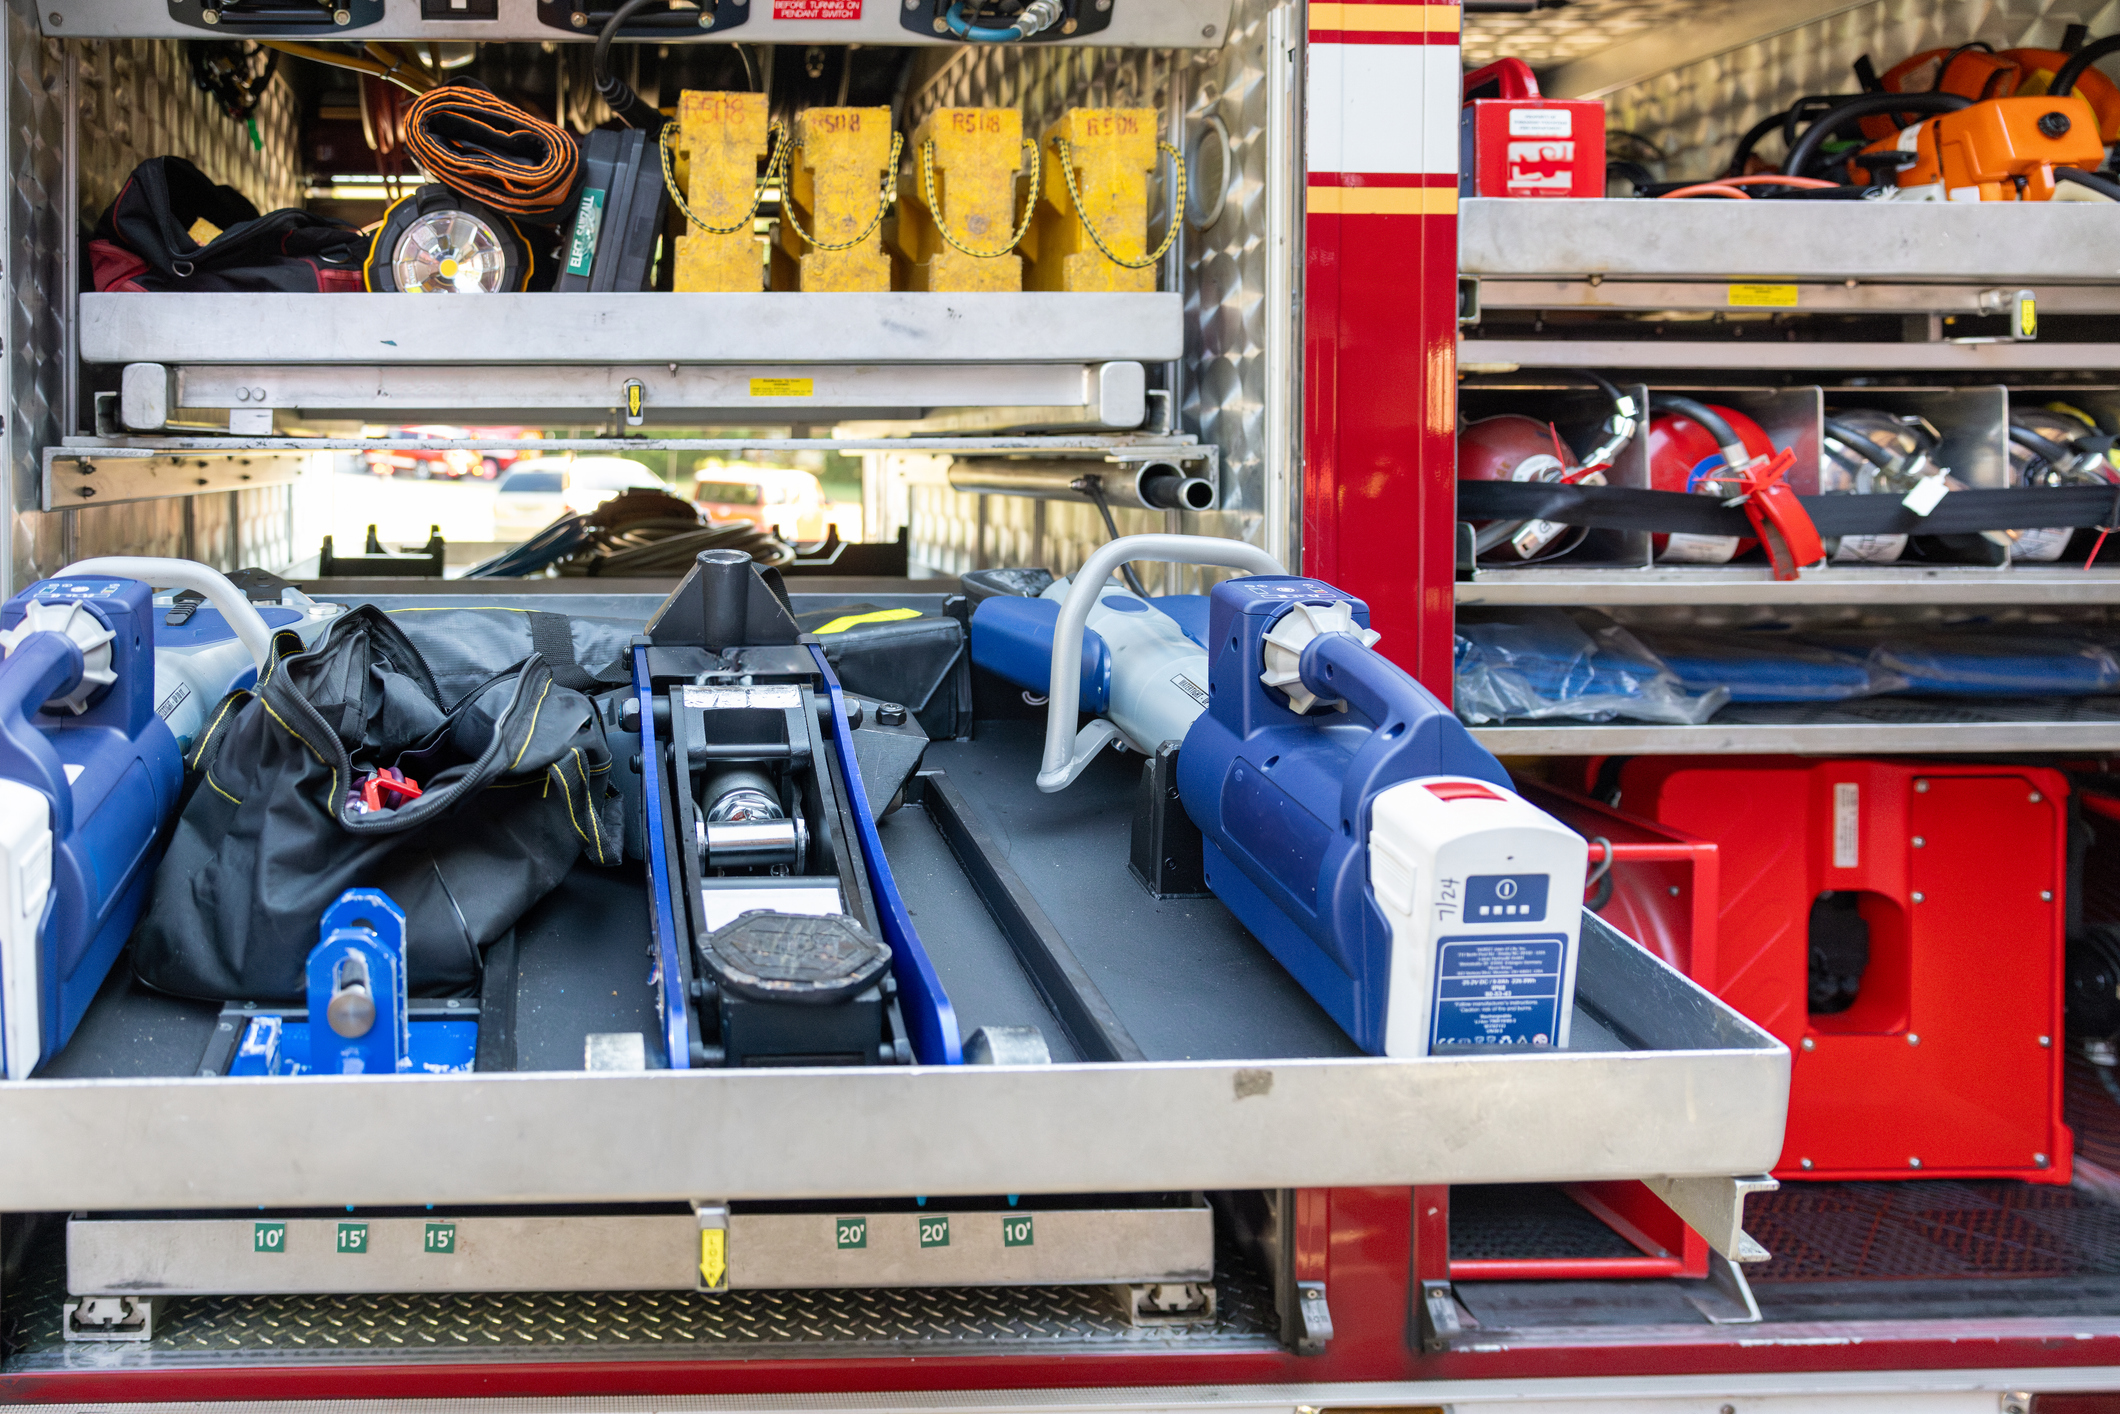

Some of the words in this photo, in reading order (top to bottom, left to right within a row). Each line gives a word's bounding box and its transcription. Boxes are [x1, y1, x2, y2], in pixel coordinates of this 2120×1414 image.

[775, 1, 806, 9] BEFORE
[810, 1, 844, 9] TURNING
[846, 1, 860, 9] ON
[781, 9, 819, 18] PENDANT
[821, 9, 853, 18] SWITCH
[1434, 877, 1461, 921] 7/24
[256, 1229, 283, 1247] 10'
[339, 1229, 366, 1247] 15'
[427, 1230, 454, 1248] 15'
[838, 1224, 865, 1243] 20'
[921, 1222, 947, 1242] 20'
[1005, 1222, 1031, 1241] 10'
